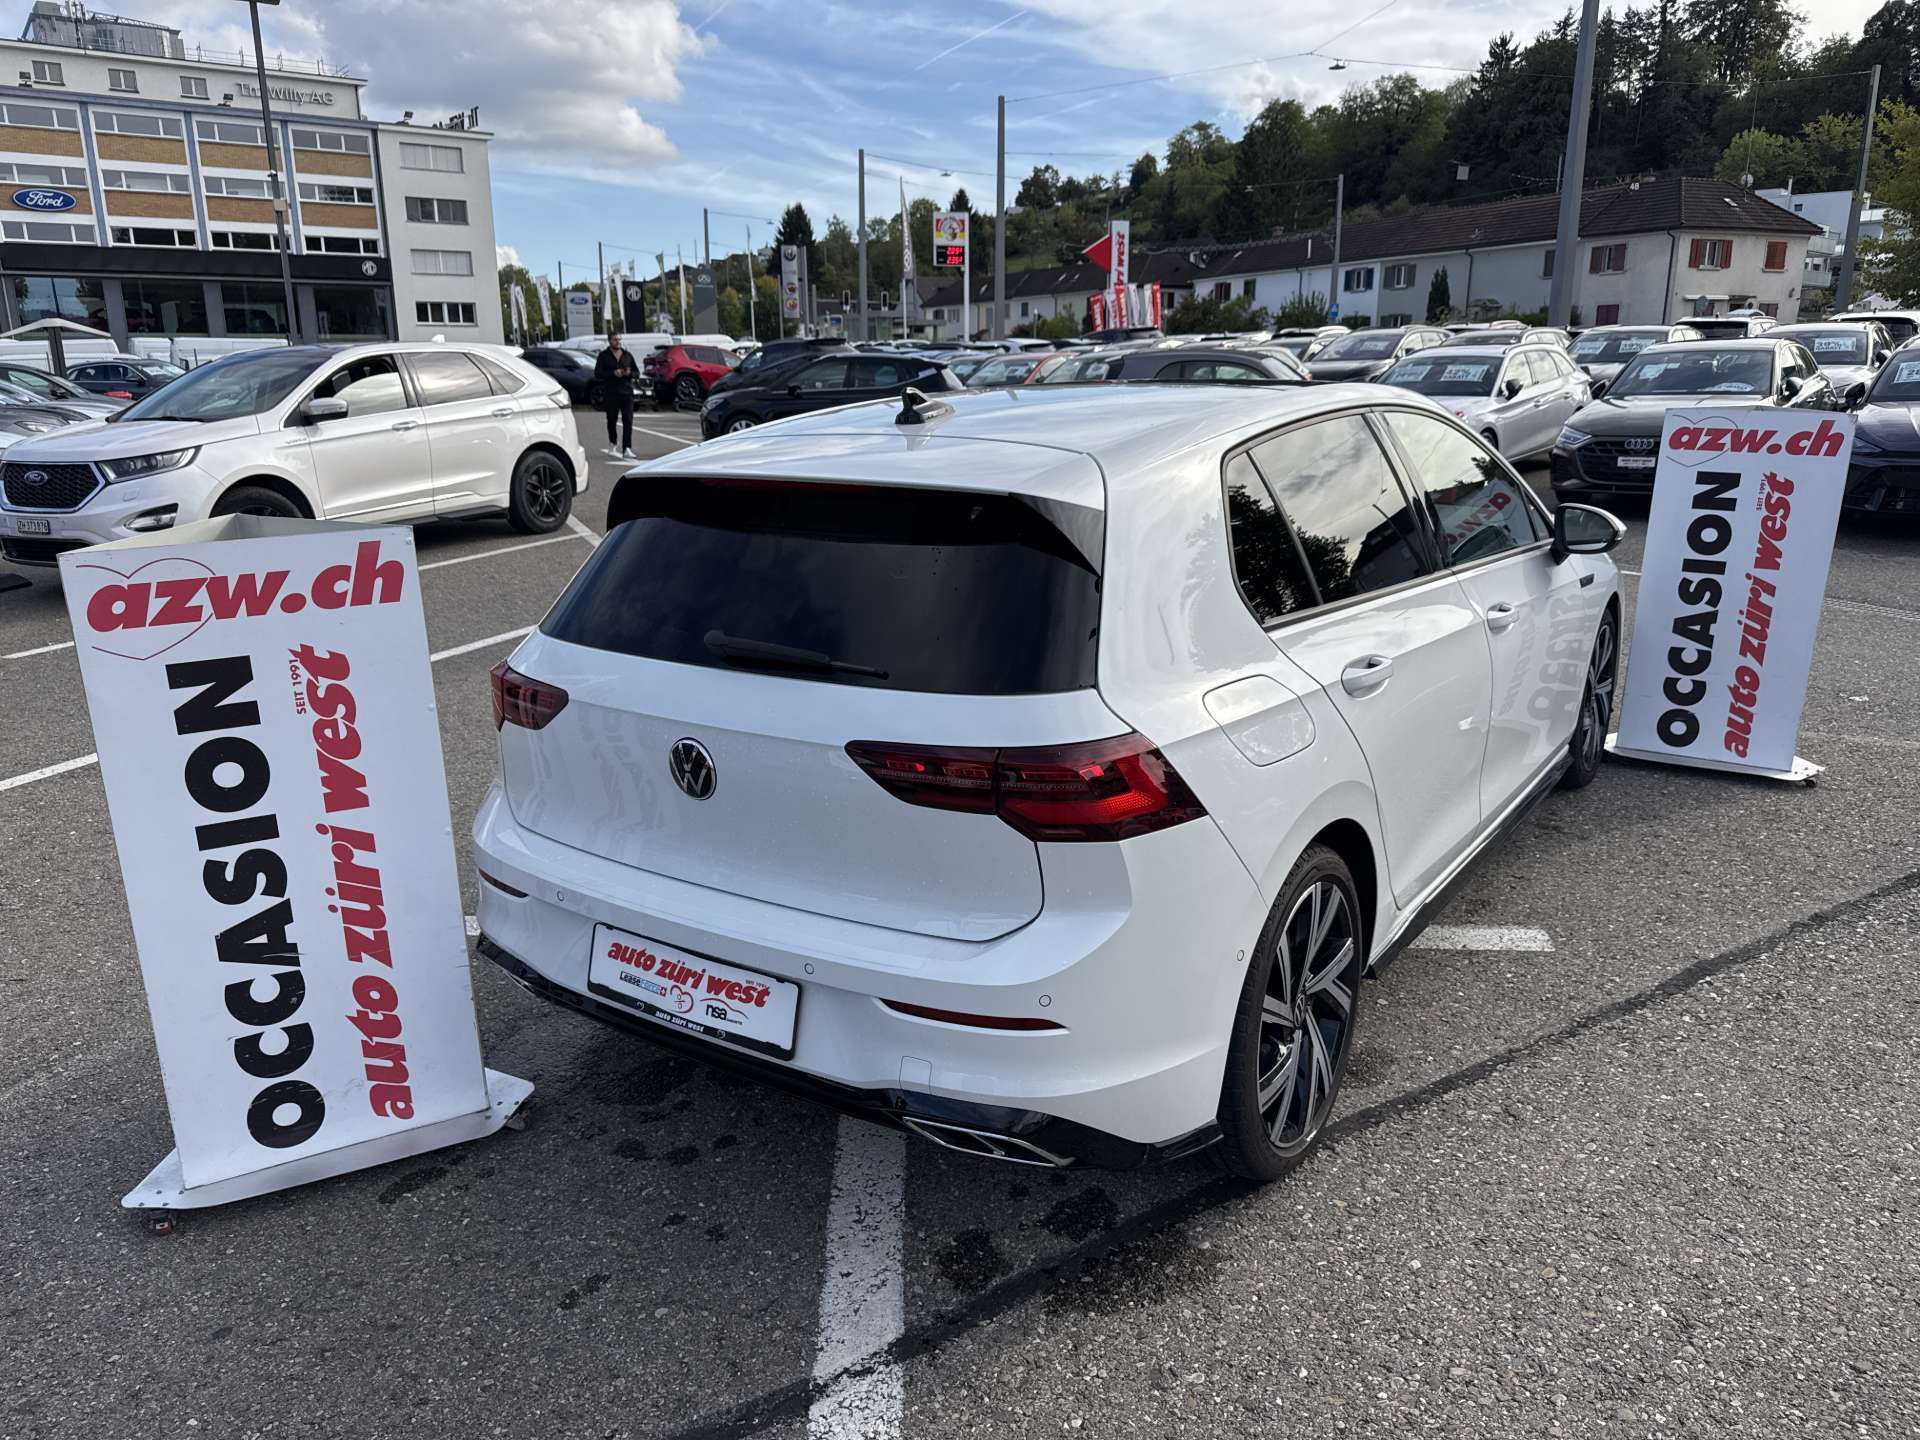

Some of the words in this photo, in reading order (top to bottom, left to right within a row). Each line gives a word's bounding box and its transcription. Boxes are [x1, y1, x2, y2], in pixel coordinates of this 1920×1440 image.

[268, 87, 306, 105] Willy
[311, 89, 335, 106] AG
[26, 190, 64, 207] Ford
[1668, 420, 1845, 458] azw.ch
[1754, 471, 1796, 572] west
[86, 540, 405, 633] azw.ch
[1656, 471, 1742, 748] OCCASION
[1736, 572, 1777, 666] züri
[288, 659, 302, 687] 1991
[295, 691, 307, 715] SEIT
[1723, 665, 1761, 759] auto
[288, 643, 370, 814] west
[164, 655, 326, 1149] OCCASION
[315, 823, 394, 969] züri
[607, 941, 656, 972] auto
[655, 959, 707, 990] züri
[706, 975, 772, 1009] west
[655, 1010, 671, 1021] auto
[687, 1021, 705, 1033] west
[705, 1003, 728, 1021] nsa
[345, 975, 415, 1121] auto
